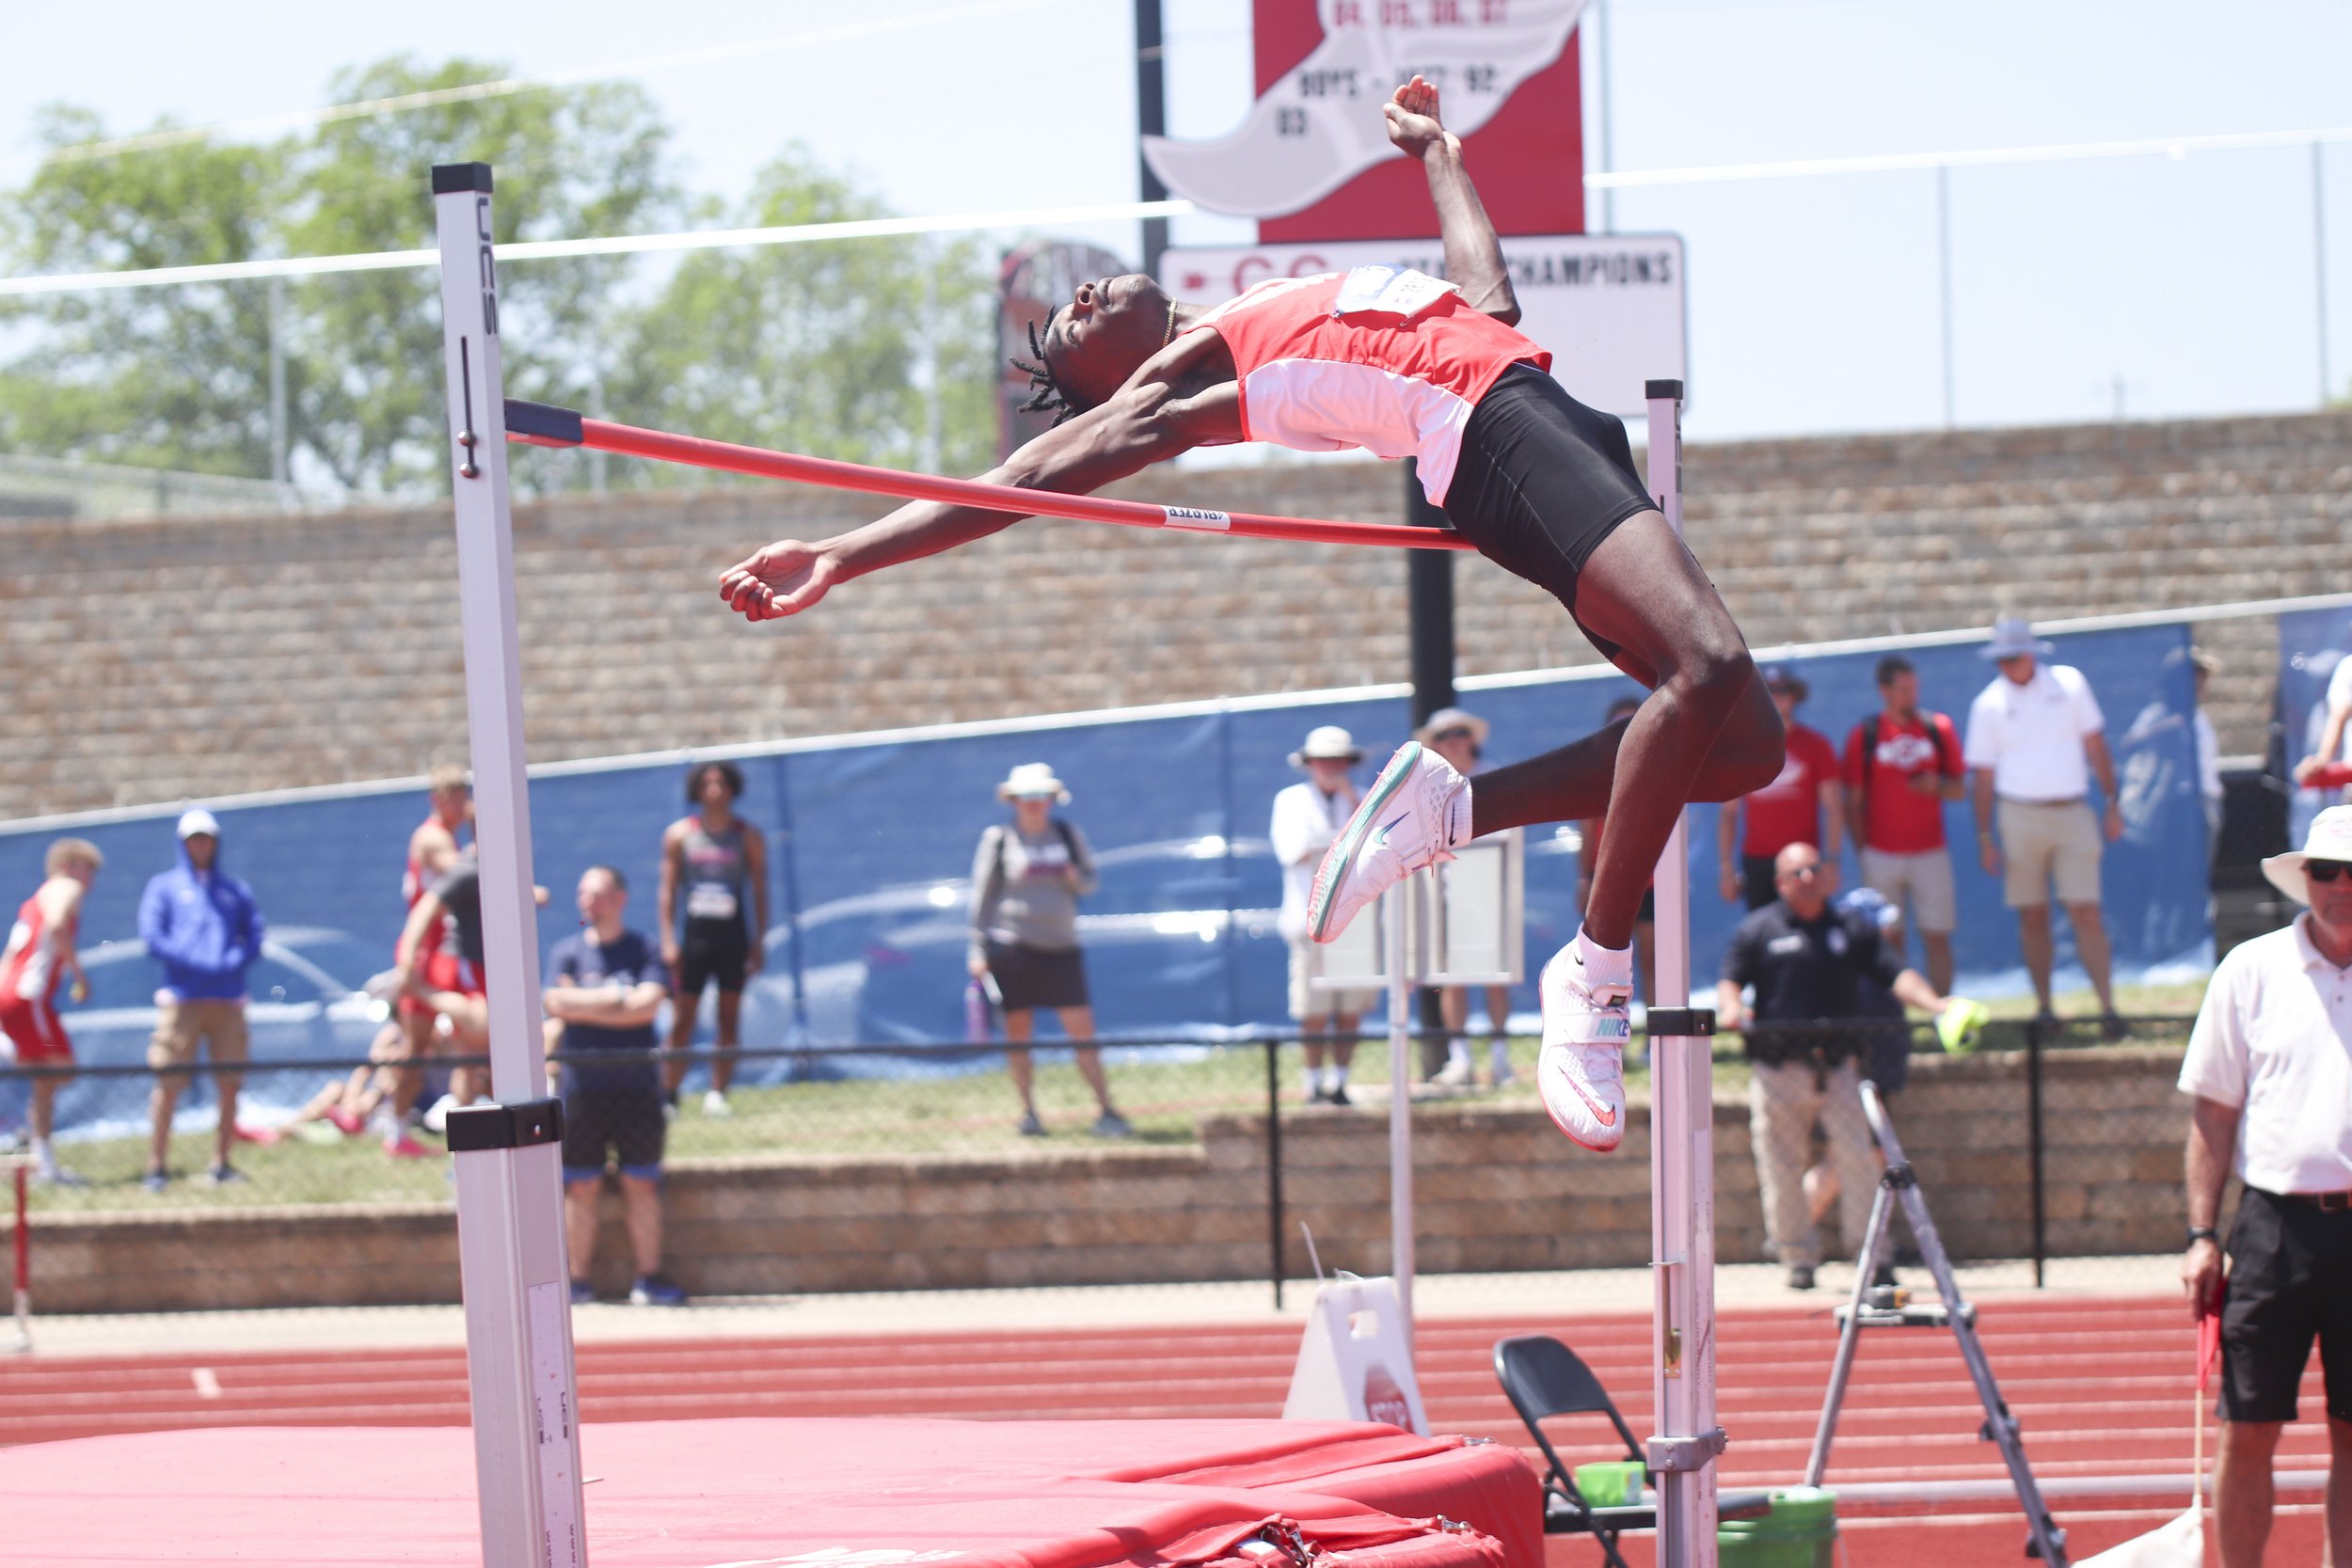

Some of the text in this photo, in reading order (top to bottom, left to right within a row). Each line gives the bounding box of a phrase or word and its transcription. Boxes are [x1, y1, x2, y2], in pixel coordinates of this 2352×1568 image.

[1299, 69, 1357, 97] BOYS
[1505, 253, 1671, 286] CHAMPIONS
[1596, 1019, 1628, 1037] NIKE
